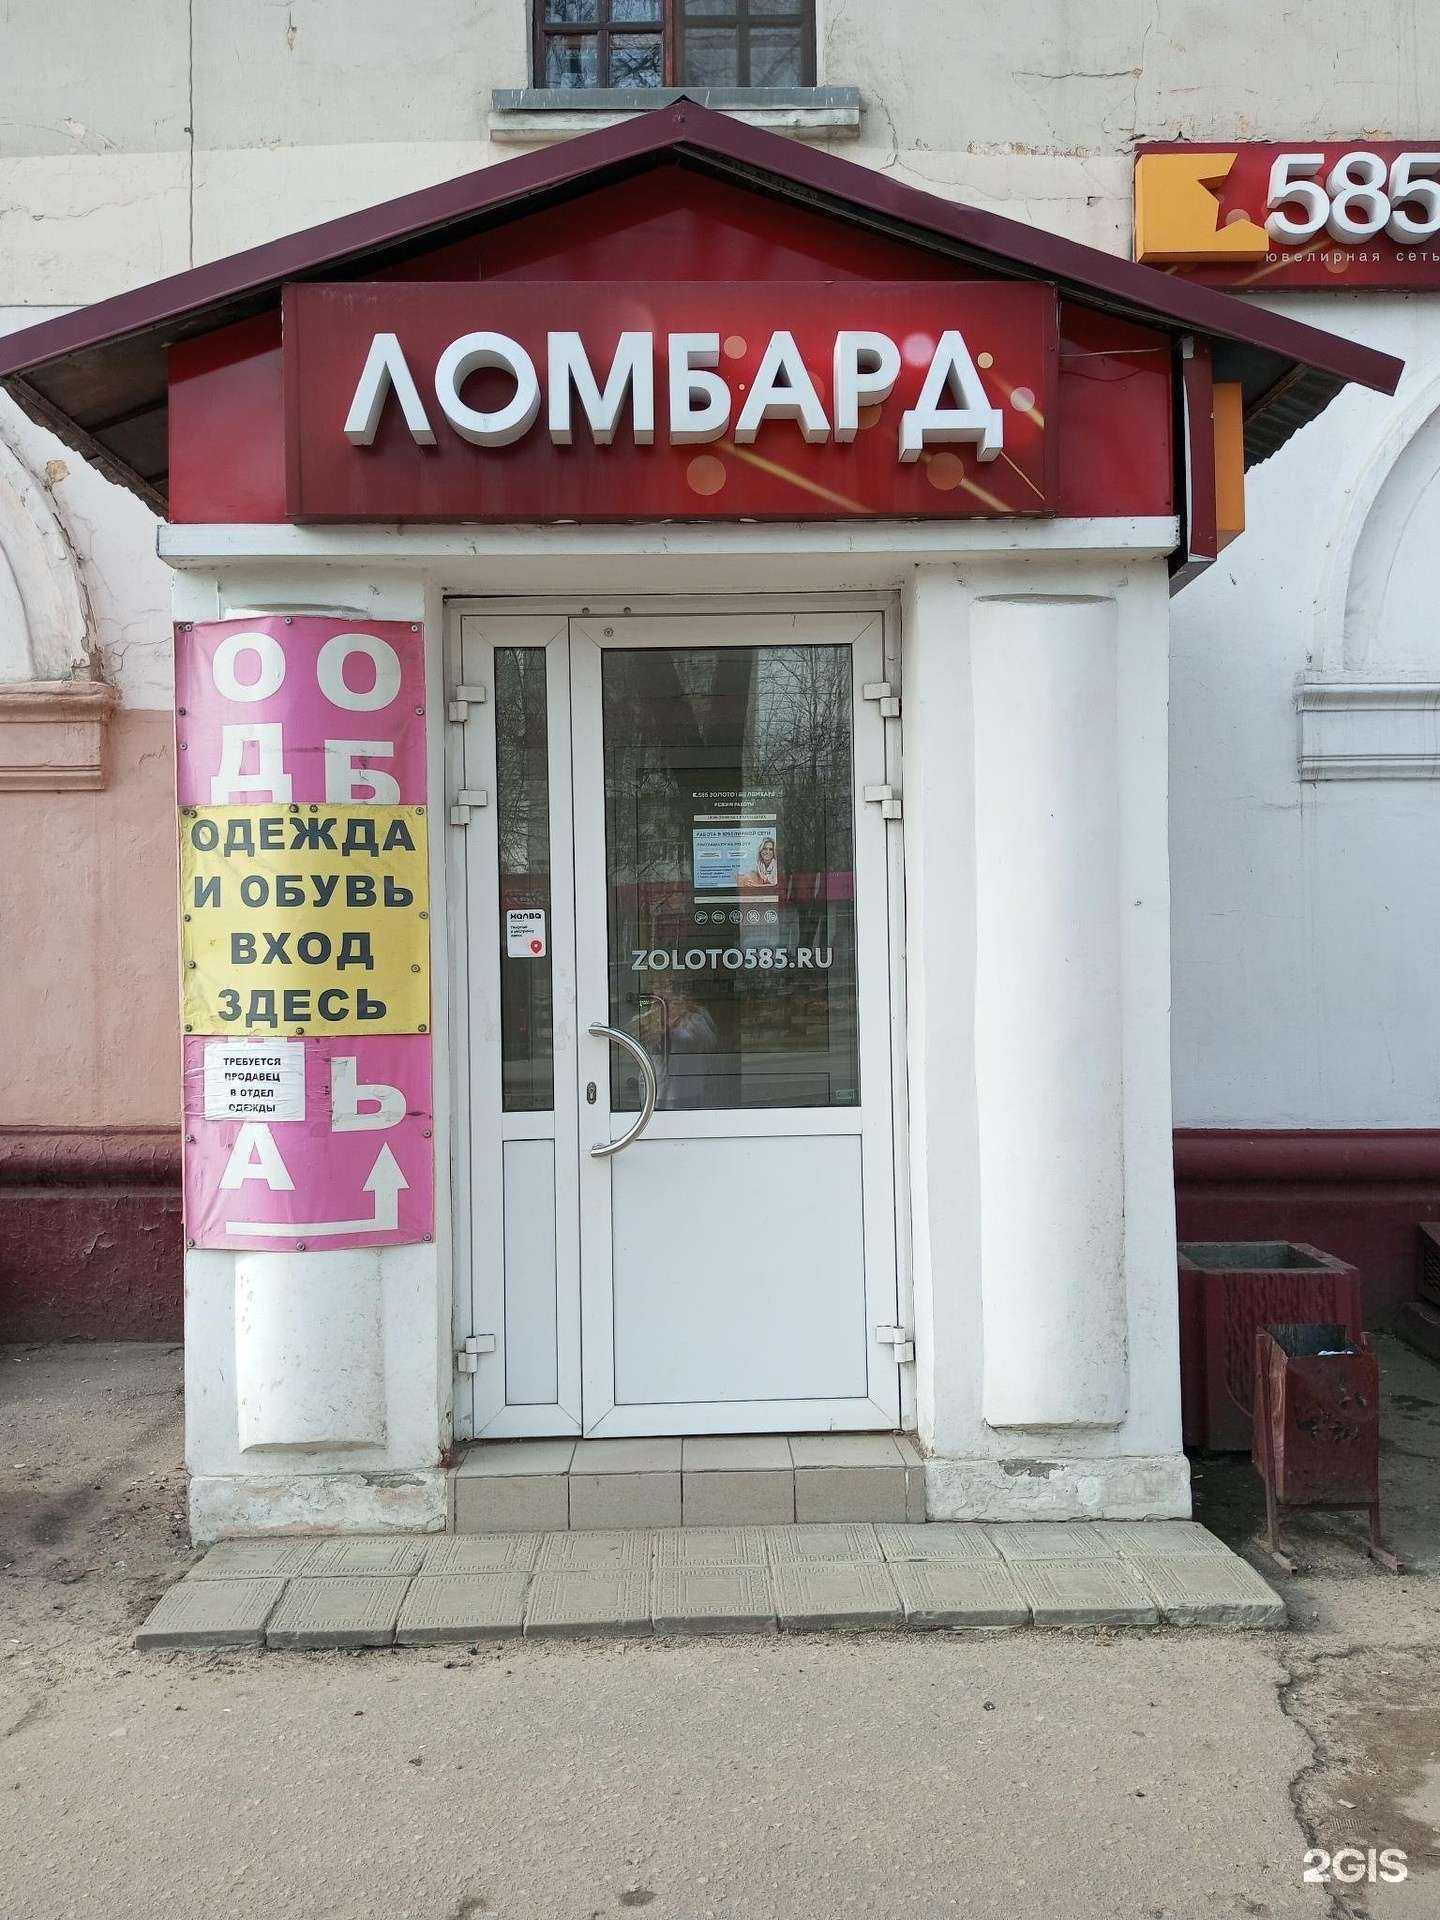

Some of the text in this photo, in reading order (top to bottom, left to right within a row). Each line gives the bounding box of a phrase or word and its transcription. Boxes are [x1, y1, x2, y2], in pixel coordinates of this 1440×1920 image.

[1265, 152, 1440, 244] 585
[1266, 252, 1440, 264] ювелирная сеть
[344, 330, 1003, 462] ЛОМБАРД
[191, 817, 416, 857] ОДЕЖДА
[193, 875, 414, 908] И ОБУВЬ
[231, 932, 374, 971] ВХОД
[631, 947, 833, 971] ZOLOTO585.RU
[217, 988, 387, 1028] ЗДЕСЬ
[223, 1057, 281, 1066] ТРЕБУЕТСЯ
[224, 1072, 281, 1082] ПРОДАВЕЦ
[230, 1088, 274, 1099] В ОТДЕЛ
[228, 1103, 276, 1113] ОДЕЖДЫ
